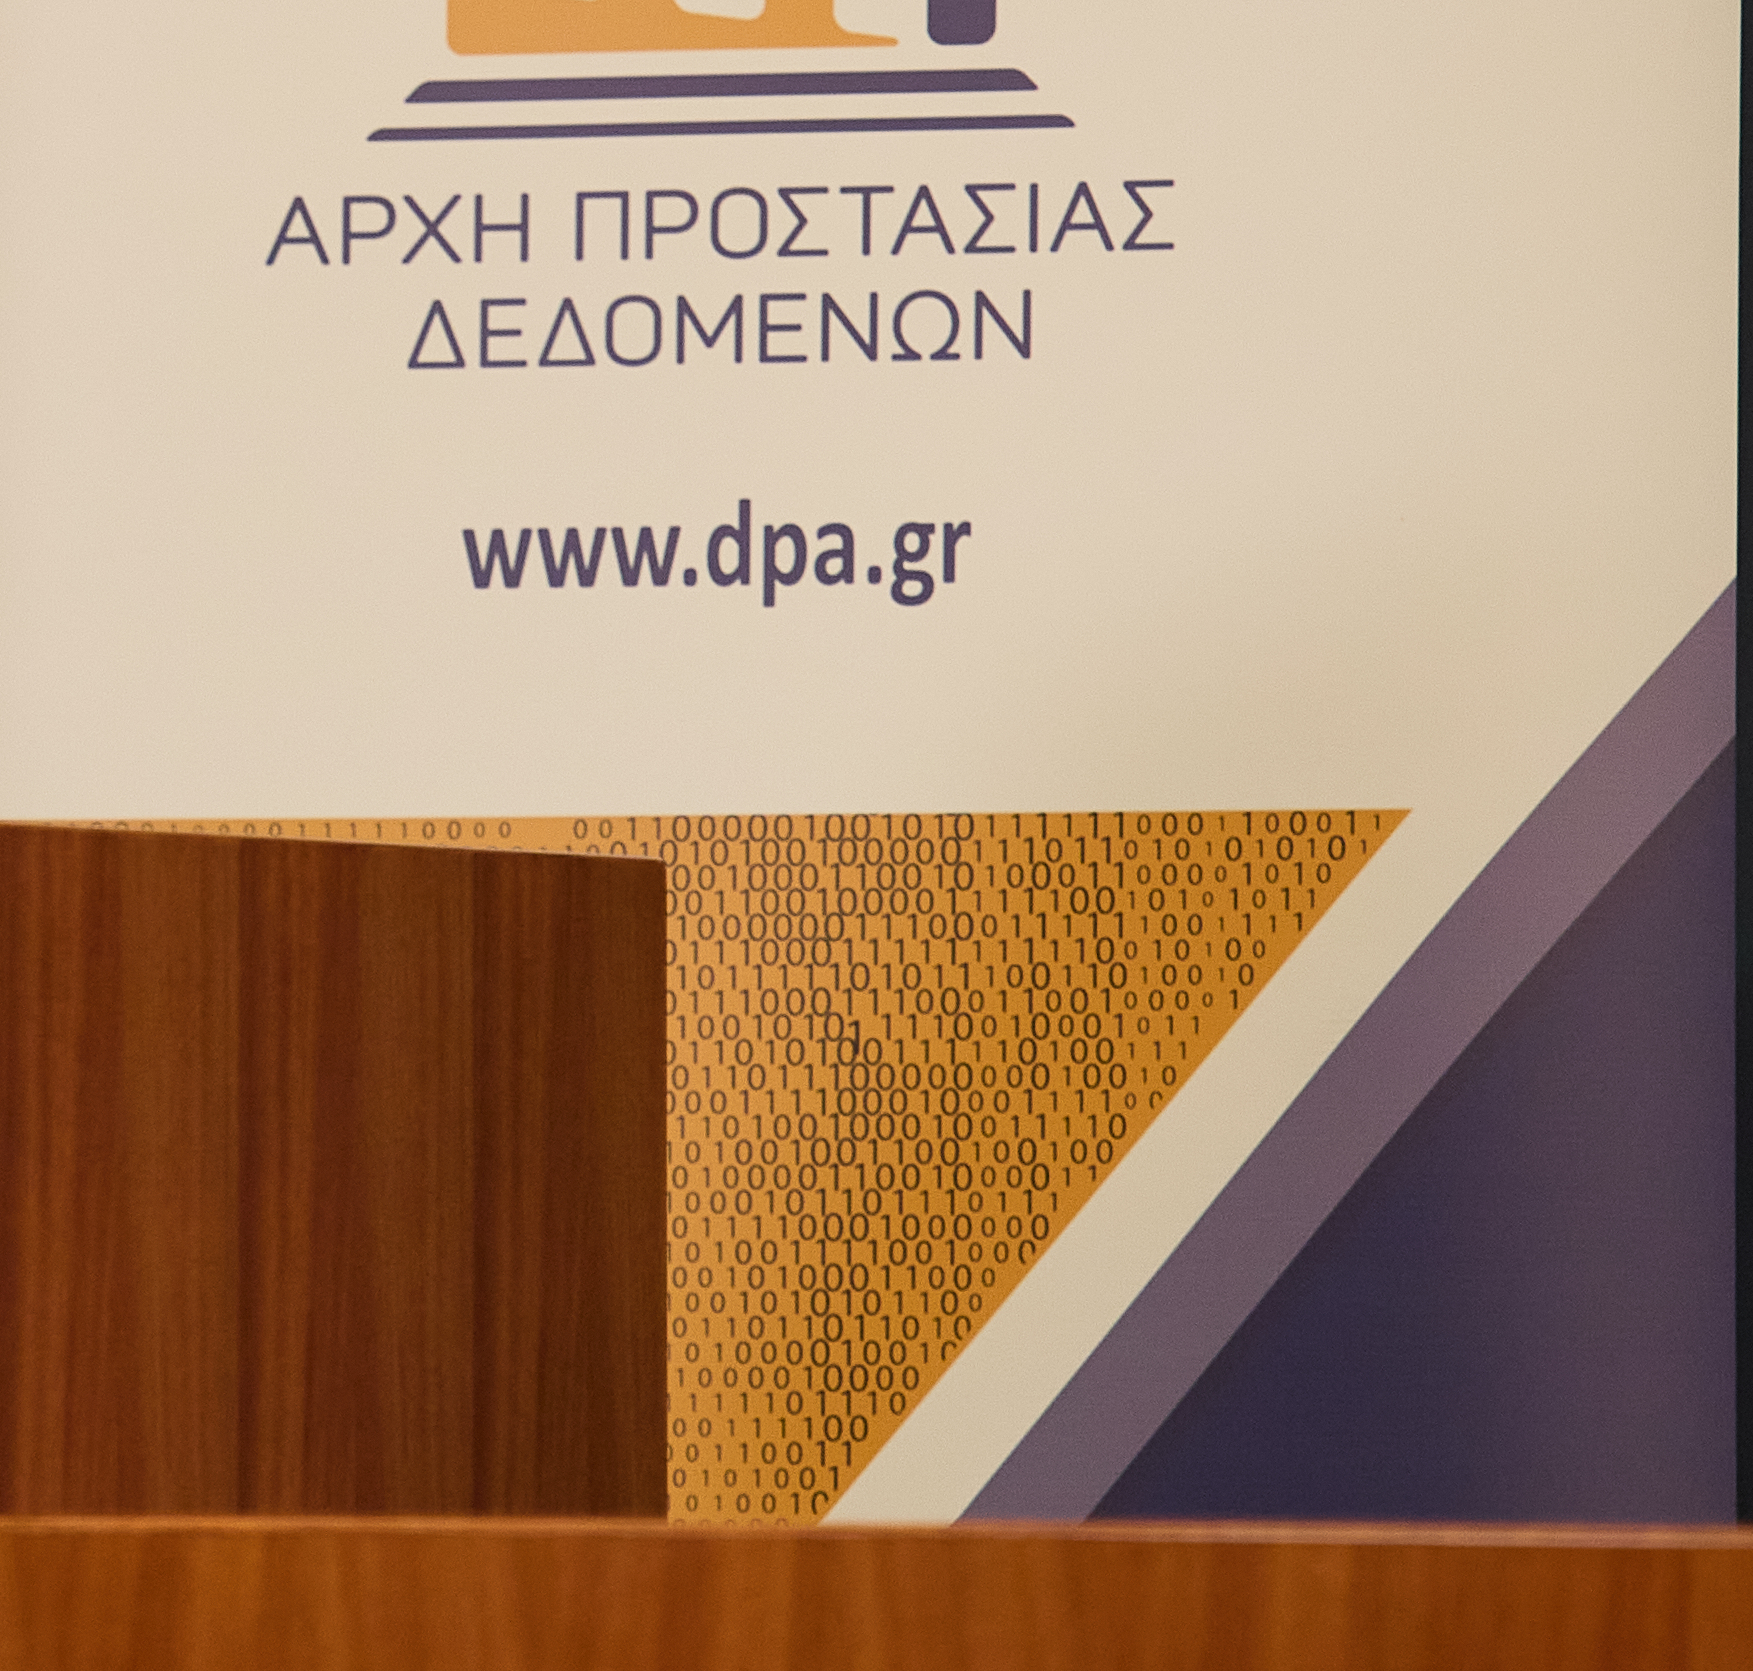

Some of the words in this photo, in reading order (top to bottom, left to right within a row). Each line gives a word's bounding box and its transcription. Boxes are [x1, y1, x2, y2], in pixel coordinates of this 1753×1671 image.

[266, 194, 528, 265] ΑΡΧΗ
[576, 180, 1173, 260] ΠΡΟΣΤΑΣΙΑΣ
[408, 290, 1030, 368] ΔΕΔΟΜΕΝΩΝ
[463, 499, 971, 607] www.dpa.gr
